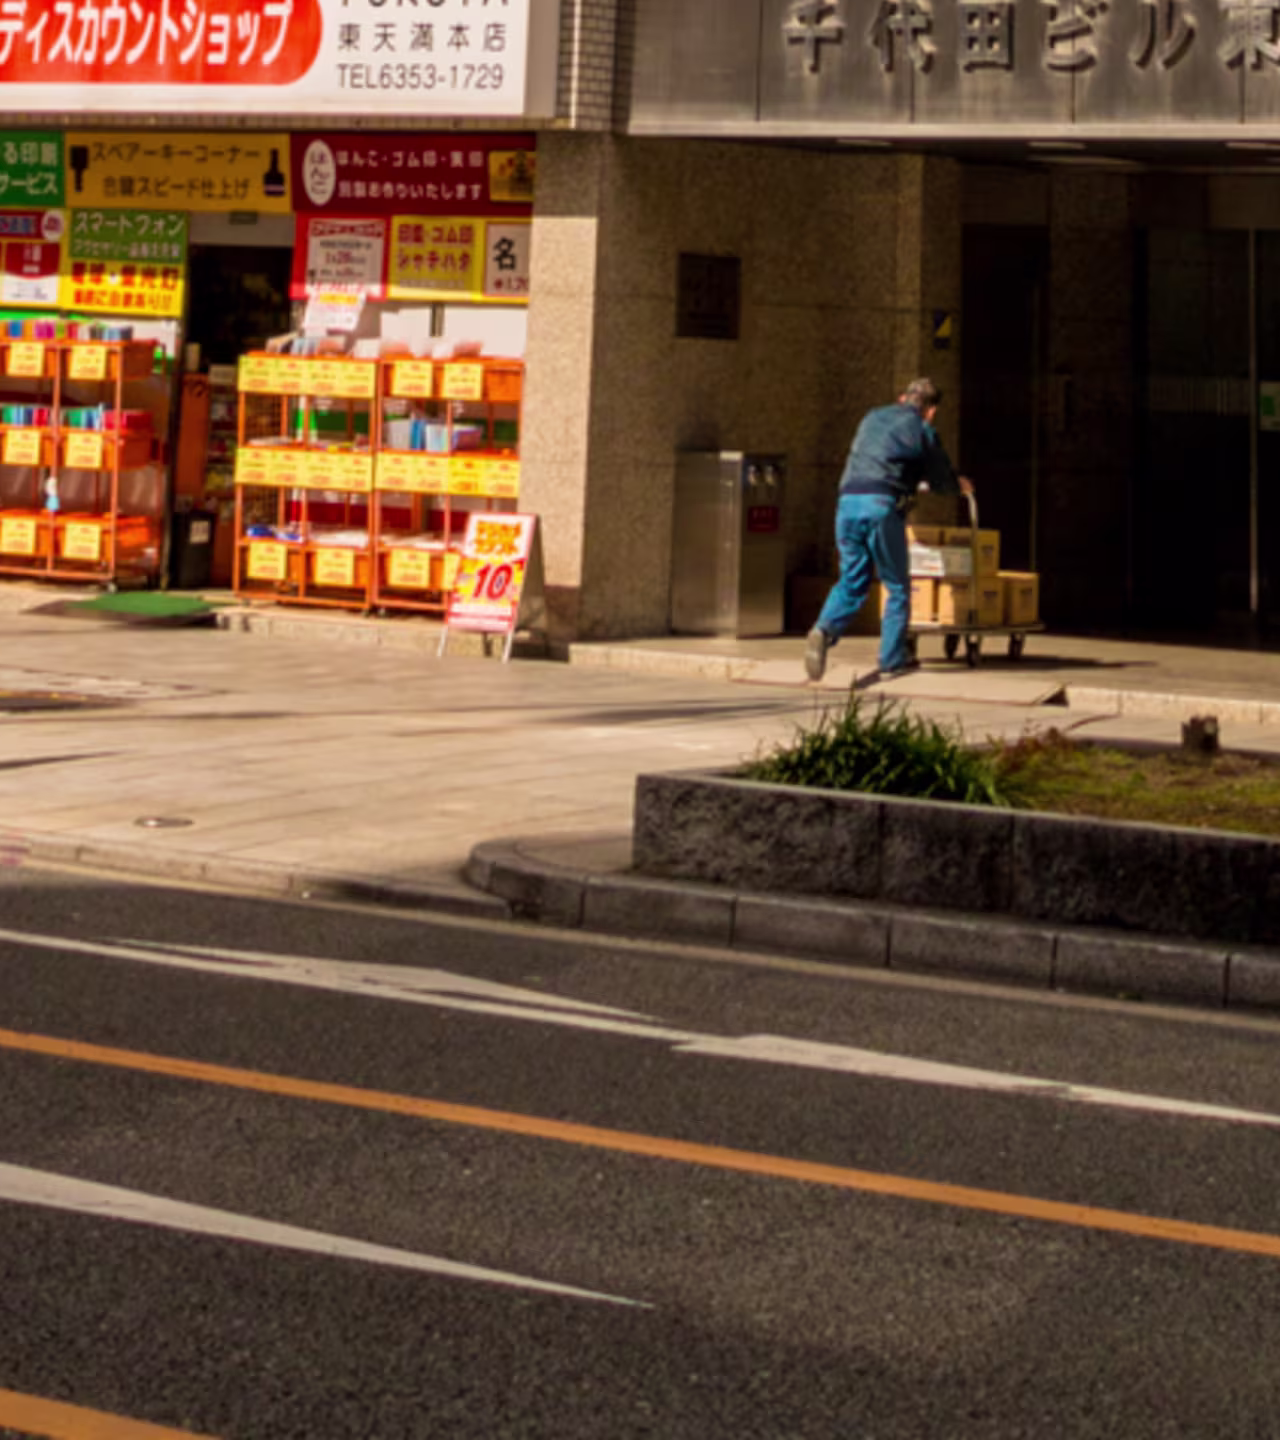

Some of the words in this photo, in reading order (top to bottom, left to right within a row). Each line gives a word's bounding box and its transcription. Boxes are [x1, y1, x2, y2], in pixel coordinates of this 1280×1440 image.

[338, 22, 507, 53] 東天満本店
[74, 211, 185, 237] スマートフォン
[472, 562, 514, 600] 10
